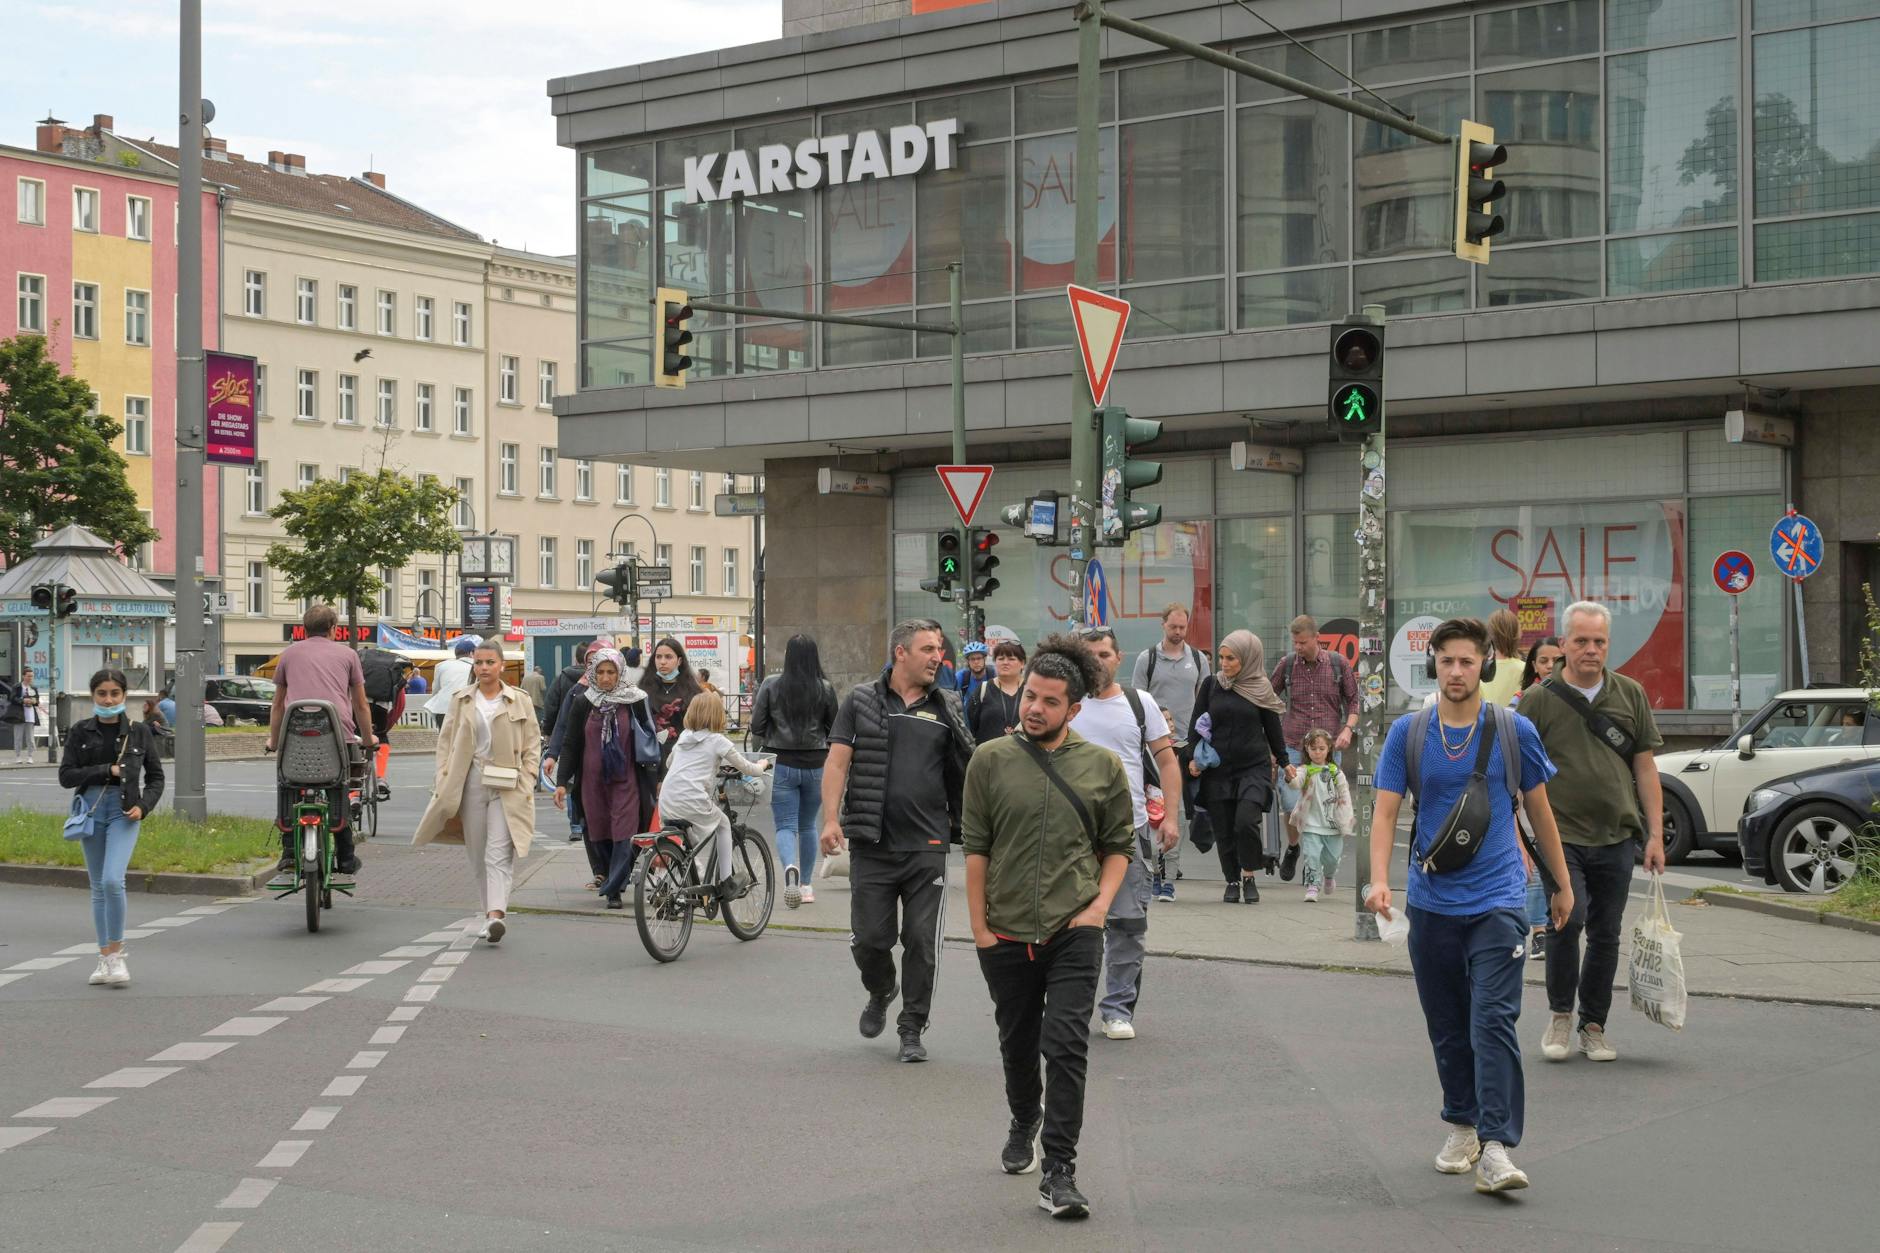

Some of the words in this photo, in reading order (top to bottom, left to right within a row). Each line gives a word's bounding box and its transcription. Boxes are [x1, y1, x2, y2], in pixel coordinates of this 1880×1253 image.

[684, 118, 960, 204] KARSTADT
[1024, 148, 1106, 211] SAL
[1487, 524, 1638, 604] SALE
[101, 602, 112, 612] EIS
[115, 603, 142, 613] GELATO
[144, 603, 166, 613] RALLO
[1517, 610, 1548, 622] 50%
[559, 622, 606, 631] Schnell-Test
[655, 619, 694, 630] chnell-Test
[1410, 631, 1430, 640] SUCH
[34, 651, 47, 664] EIS
[690, 658, 722, 668] hnell-Test
